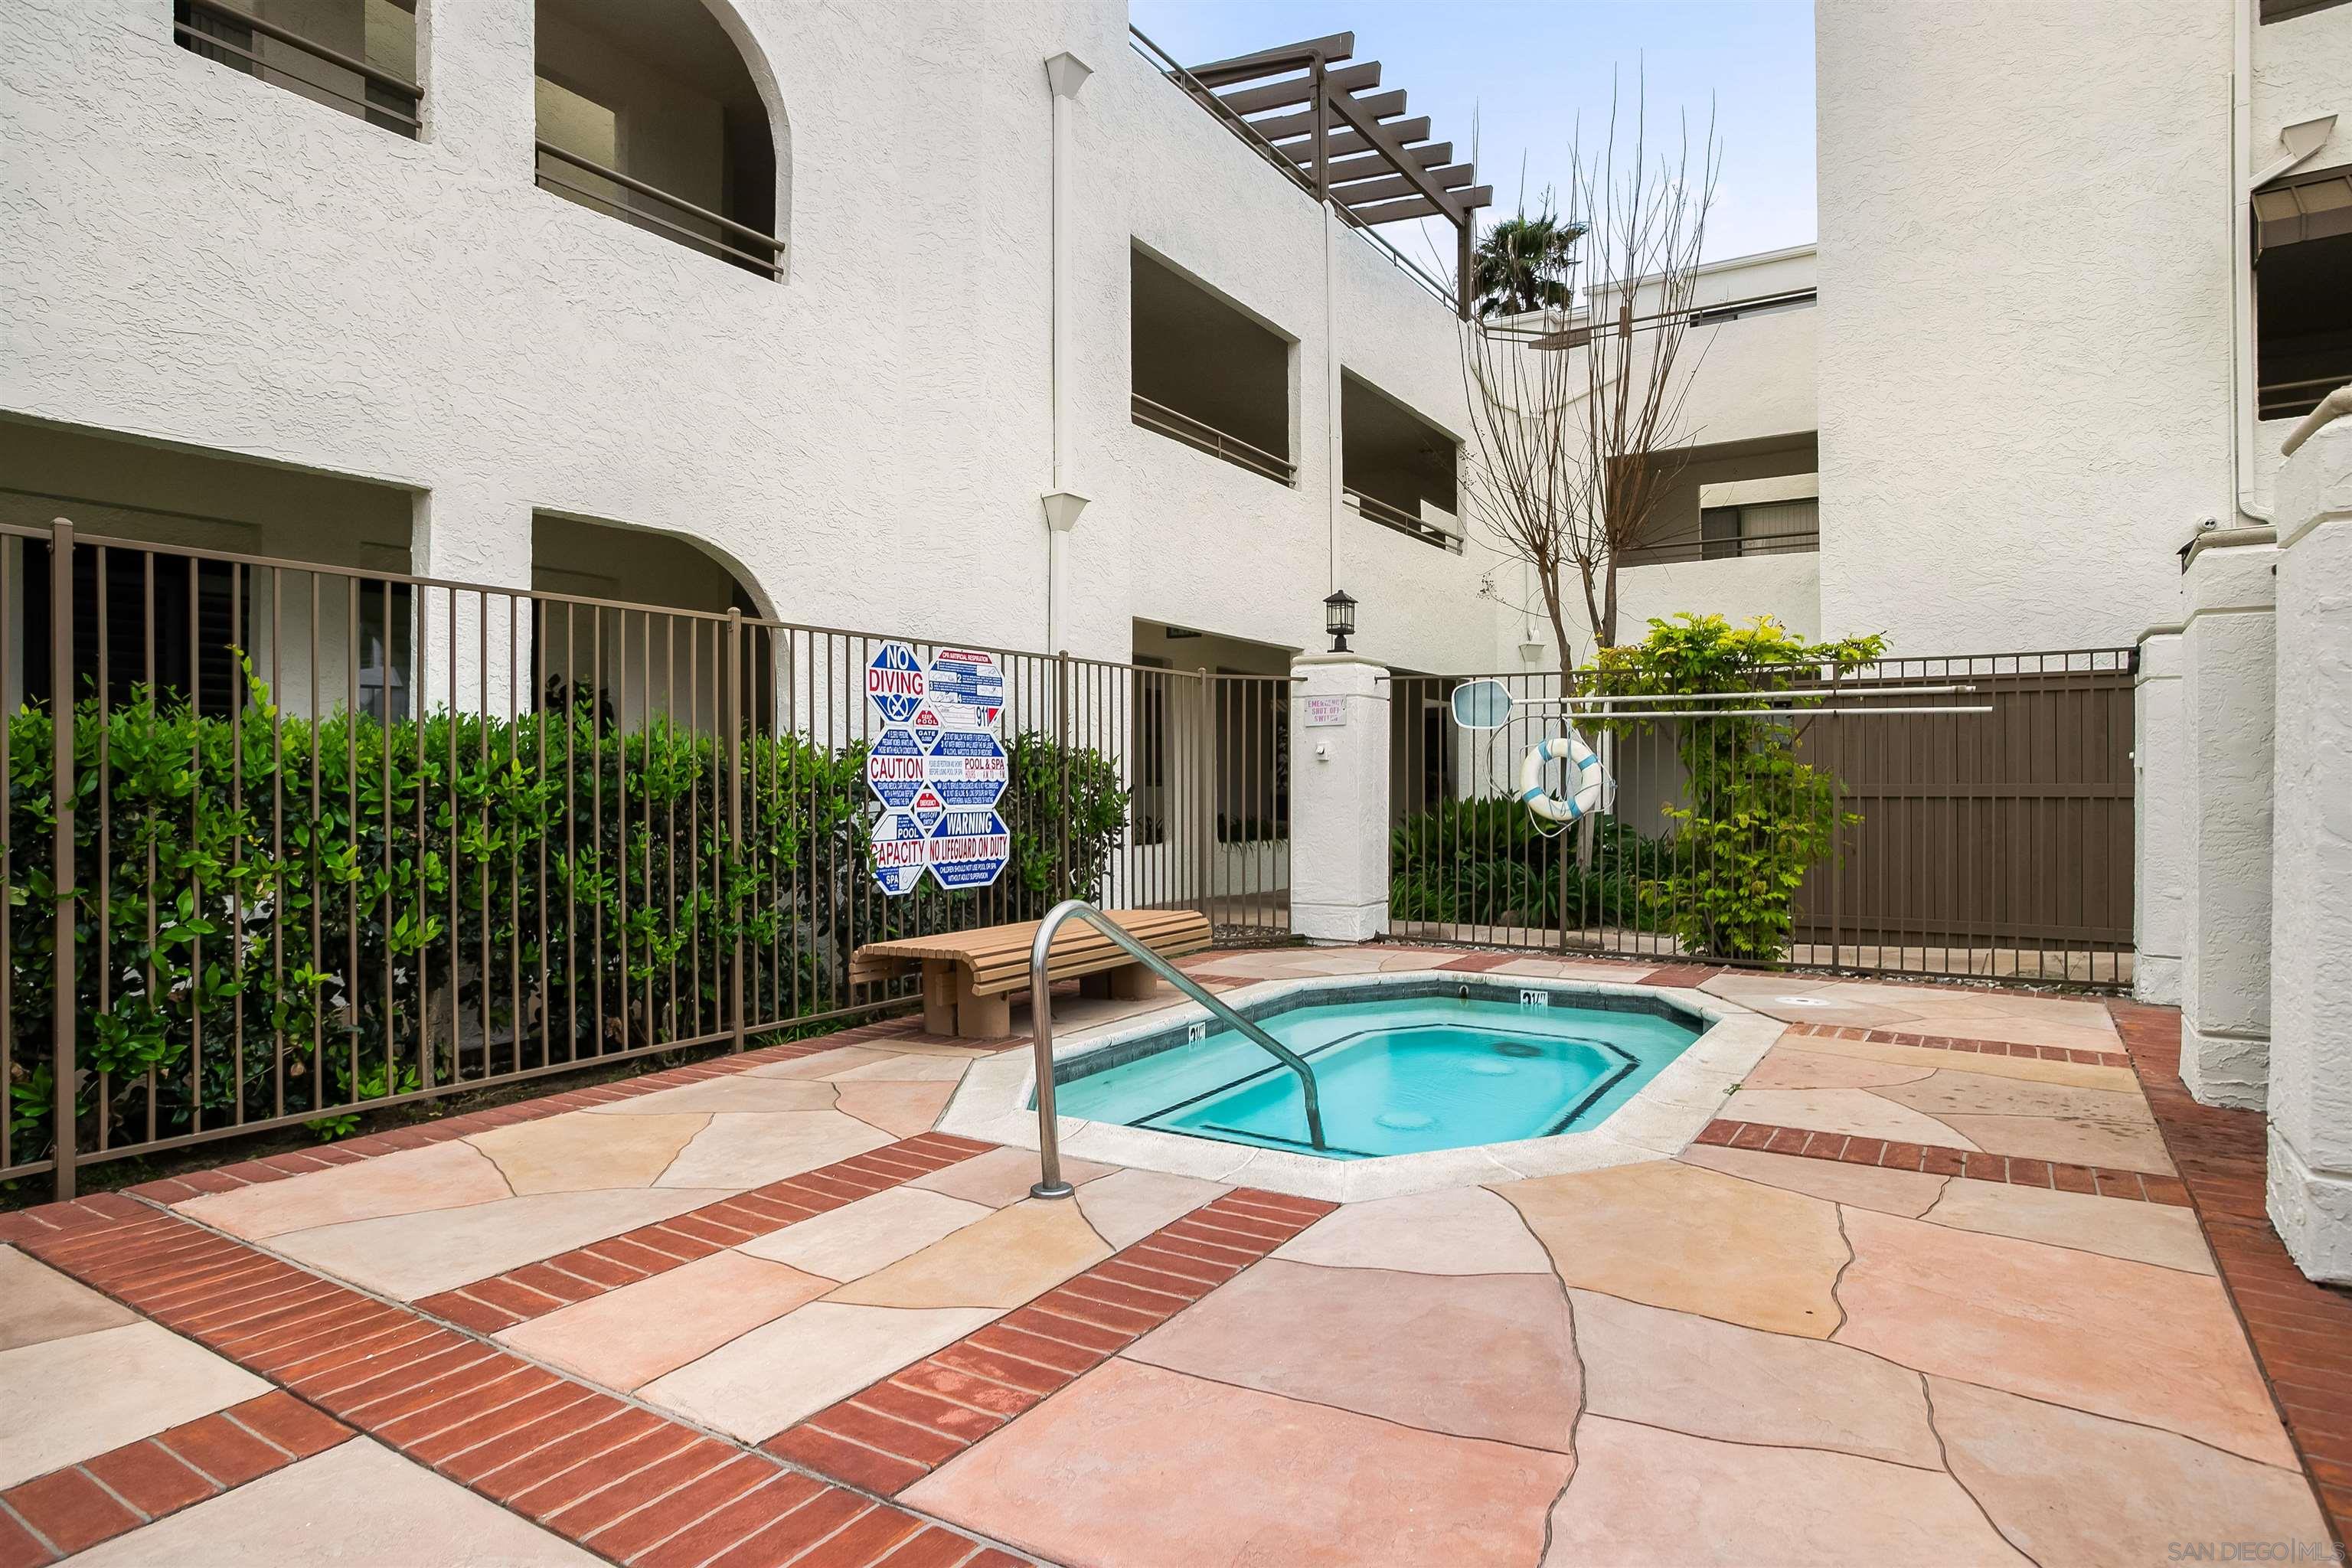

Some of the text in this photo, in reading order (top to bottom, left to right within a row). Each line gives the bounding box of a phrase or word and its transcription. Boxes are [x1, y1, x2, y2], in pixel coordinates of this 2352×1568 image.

[887, 645, 909, 670] NO
[869, 668, 923, 695] DIVING
[957, 674, 962, 683] 2
[929, 681, 933, 690] 3
[958, 694, 962, 704] 4
[976, 706, 989, 727] 911
[871, 757, 923, 779] CAUTION
[965, 758, 984, 769] POOL
[985, 758, 990, 769] &
[991, 758, 1004, 769] SPA
[946, 812, 992, 835] WARNING
[898, 828, 919, 839] POOL
[930, 835, 1007, 861] NO LIFEGUARD ON DUTY
[940, 865, 954, 874] CHILDREN
[886, 874, 899, 884] SPA
[970, 872, 988, 880] SUPERVISION
